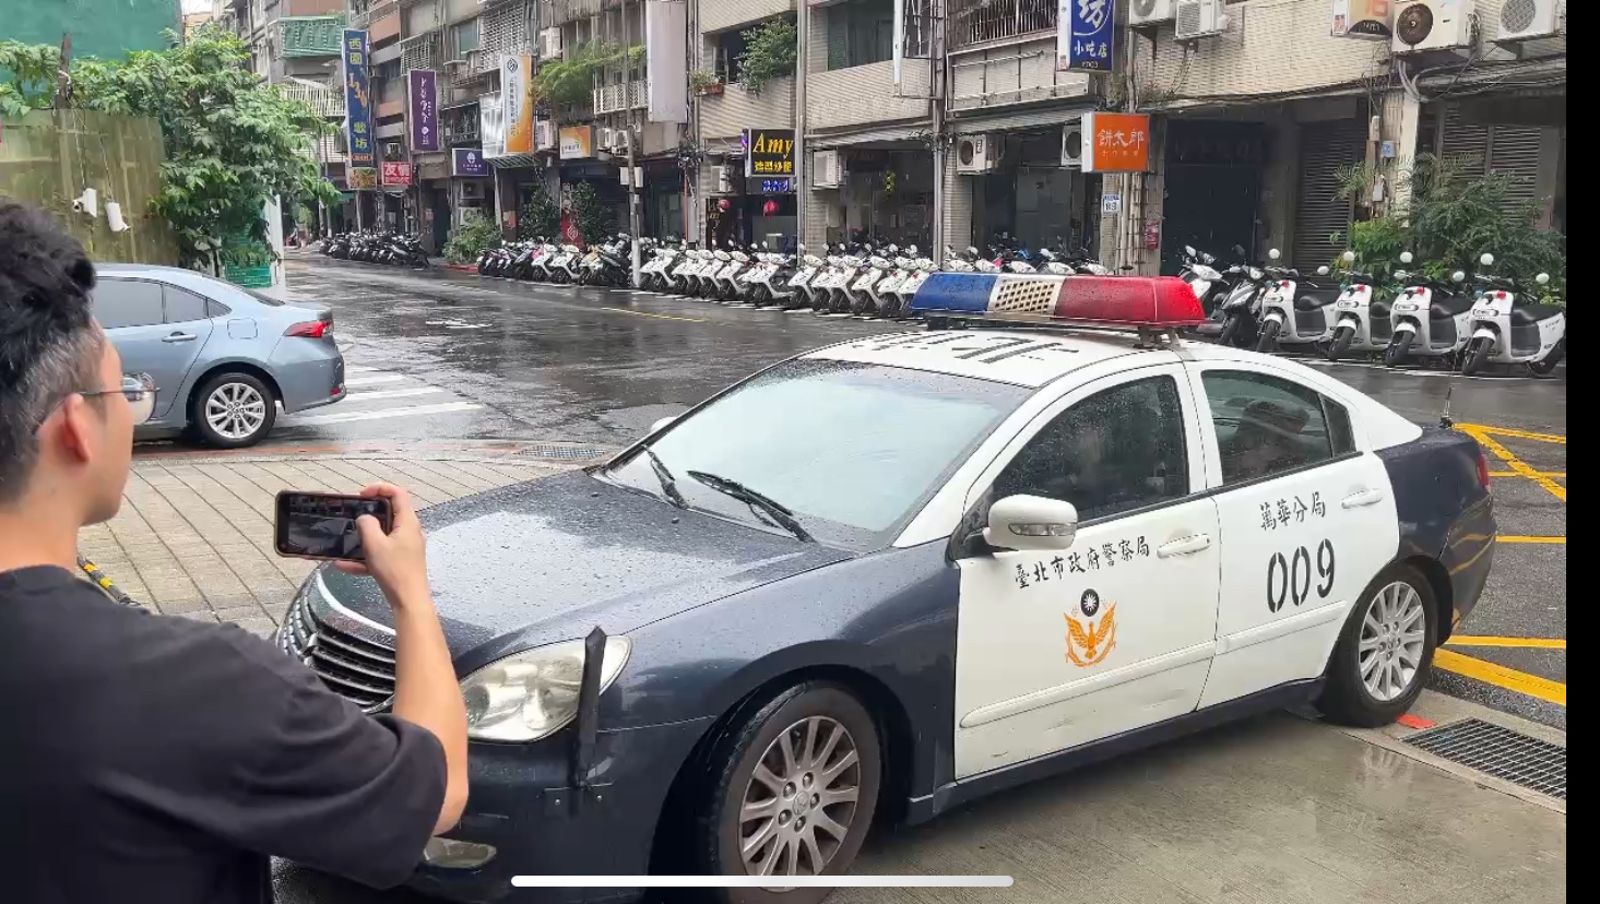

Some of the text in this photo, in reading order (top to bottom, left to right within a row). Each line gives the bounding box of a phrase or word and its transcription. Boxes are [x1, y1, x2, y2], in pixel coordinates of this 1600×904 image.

[1073, 39, 1108, 58] 小吃店
[752, 132, 794, 160] Amy
[1097, 128, 1145, 150] 餅太郎
[1259, 491, 1327, 532] 萬華分局
[1014, 535, 1151, 590] 臺北市政府警察局
[1266, 538, 1336, 614] 009
